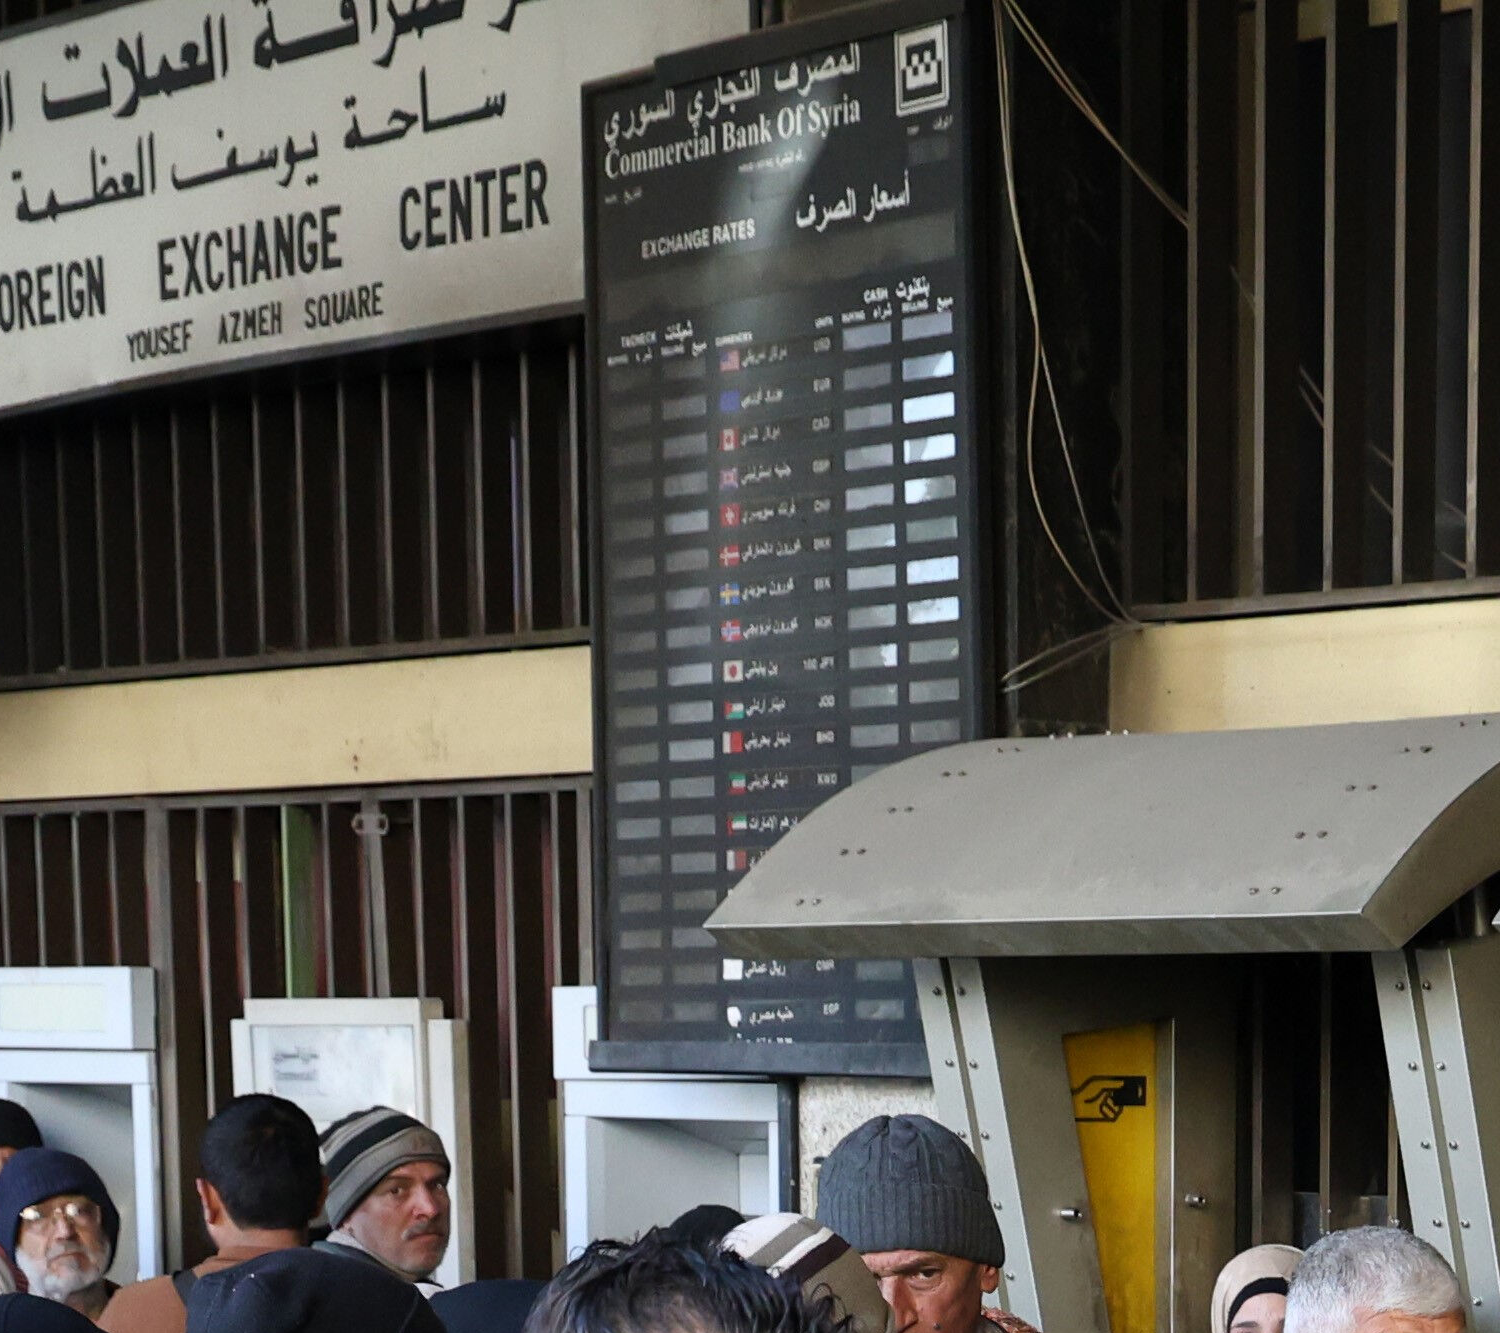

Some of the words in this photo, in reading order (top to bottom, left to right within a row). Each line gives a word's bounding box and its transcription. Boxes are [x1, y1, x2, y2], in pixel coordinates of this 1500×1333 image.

[42, 12, 228, 121] العملات
[687, 66, 761, 137] التجاري
[773, 41, 861, 97] المصرف
[344, 65, 507, 150] ساحة
[604, 88, 676, 150] السوري
[605, 125, 717, 180] Commercial
[722, 113, 773, 153] Bank
[777, 103, 805, 139] Of
[807, 93, 861, 139] Syria
[11, 130, 156, 223] العظمة
[170, 128, 319, 192] يوسف
[863, 168, 911, 223] أسعار
[158, 204, 344, 301] EXCHANGE
[399, 158, 551, 252] CENTER
[641, 227, 710, 260] EXCHANGE
[712, 217, 756, 245] RATES
[795, 186, 857, 233] الصرف
[127, 319, 193, 364] YOUSEF
[218, 309, 283, 346] AZMEH
[304, 282, 385, 332] SQUARE
